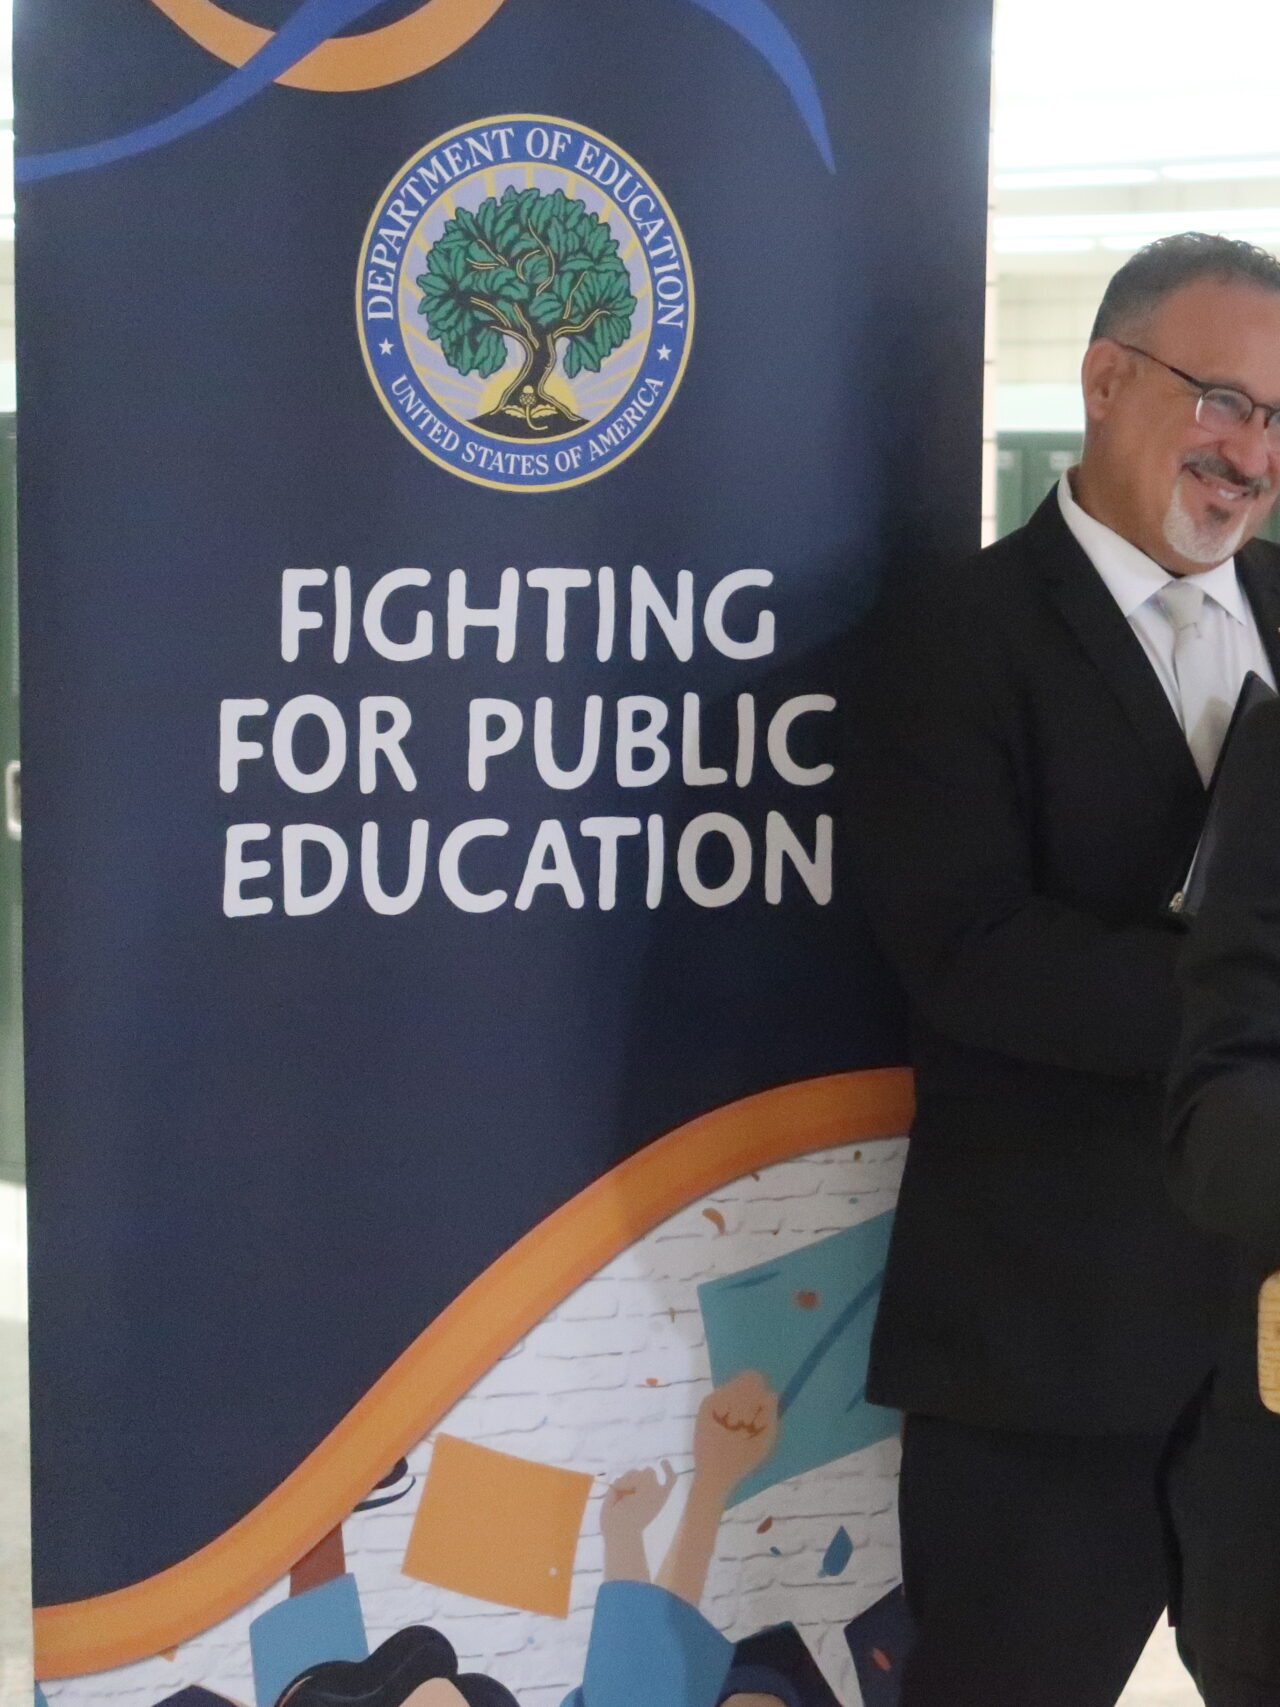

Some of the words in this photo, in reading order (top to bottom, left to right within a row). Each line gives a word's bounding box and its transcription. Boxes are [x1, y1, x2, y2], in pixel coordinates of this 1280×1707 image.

[367, 127, 515, 321] DEPARTMENT
[525, 127, 572, 160] OF
[574, 141, 684, 328] EDUCATION
[391, 374, 461, 452] UNITED
[462, 441, 549, 476] STATES
[554, 446, 583, 473] OF
[587, 376, 665, 461] AMERICA
[281, 565, 775, 663] FIGHTING
[219, 694, 417, 794] FOR
[468, 692, 837, 791] PUBLIC
[222, 810, 833, 918] EDUCATION
